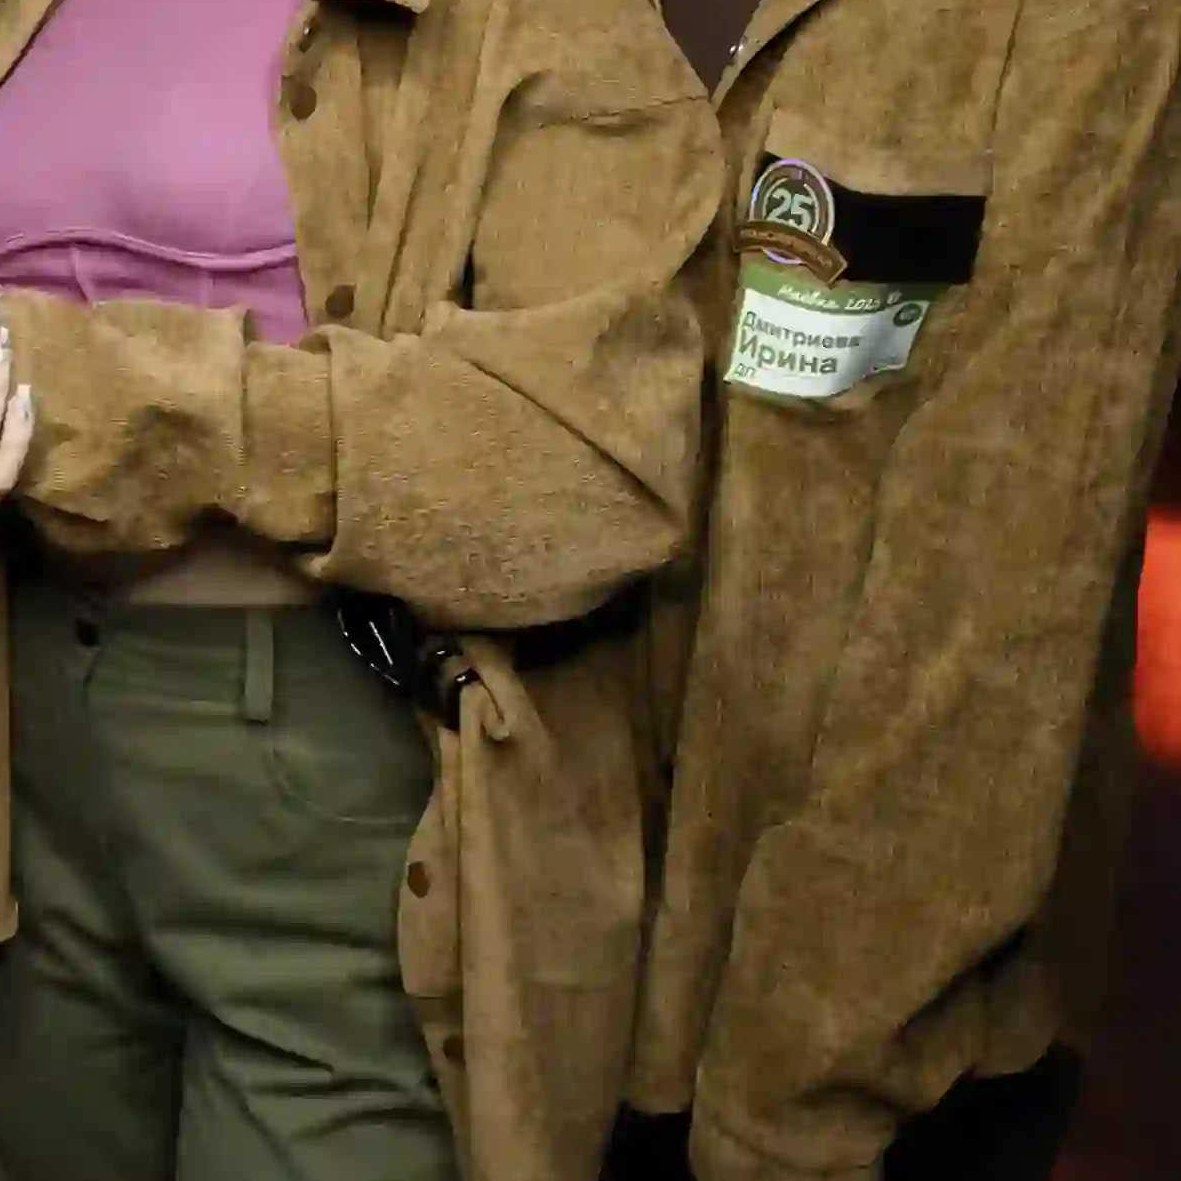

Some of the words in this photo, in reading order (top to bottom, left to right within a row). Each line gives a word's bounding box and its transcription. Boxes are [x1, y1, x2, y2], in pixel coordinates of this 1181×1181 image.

[766, 187, 813, 233] 25
[738, 328, 838, 375] Ирина
[742, 310, 862, 349] Дмитриева
